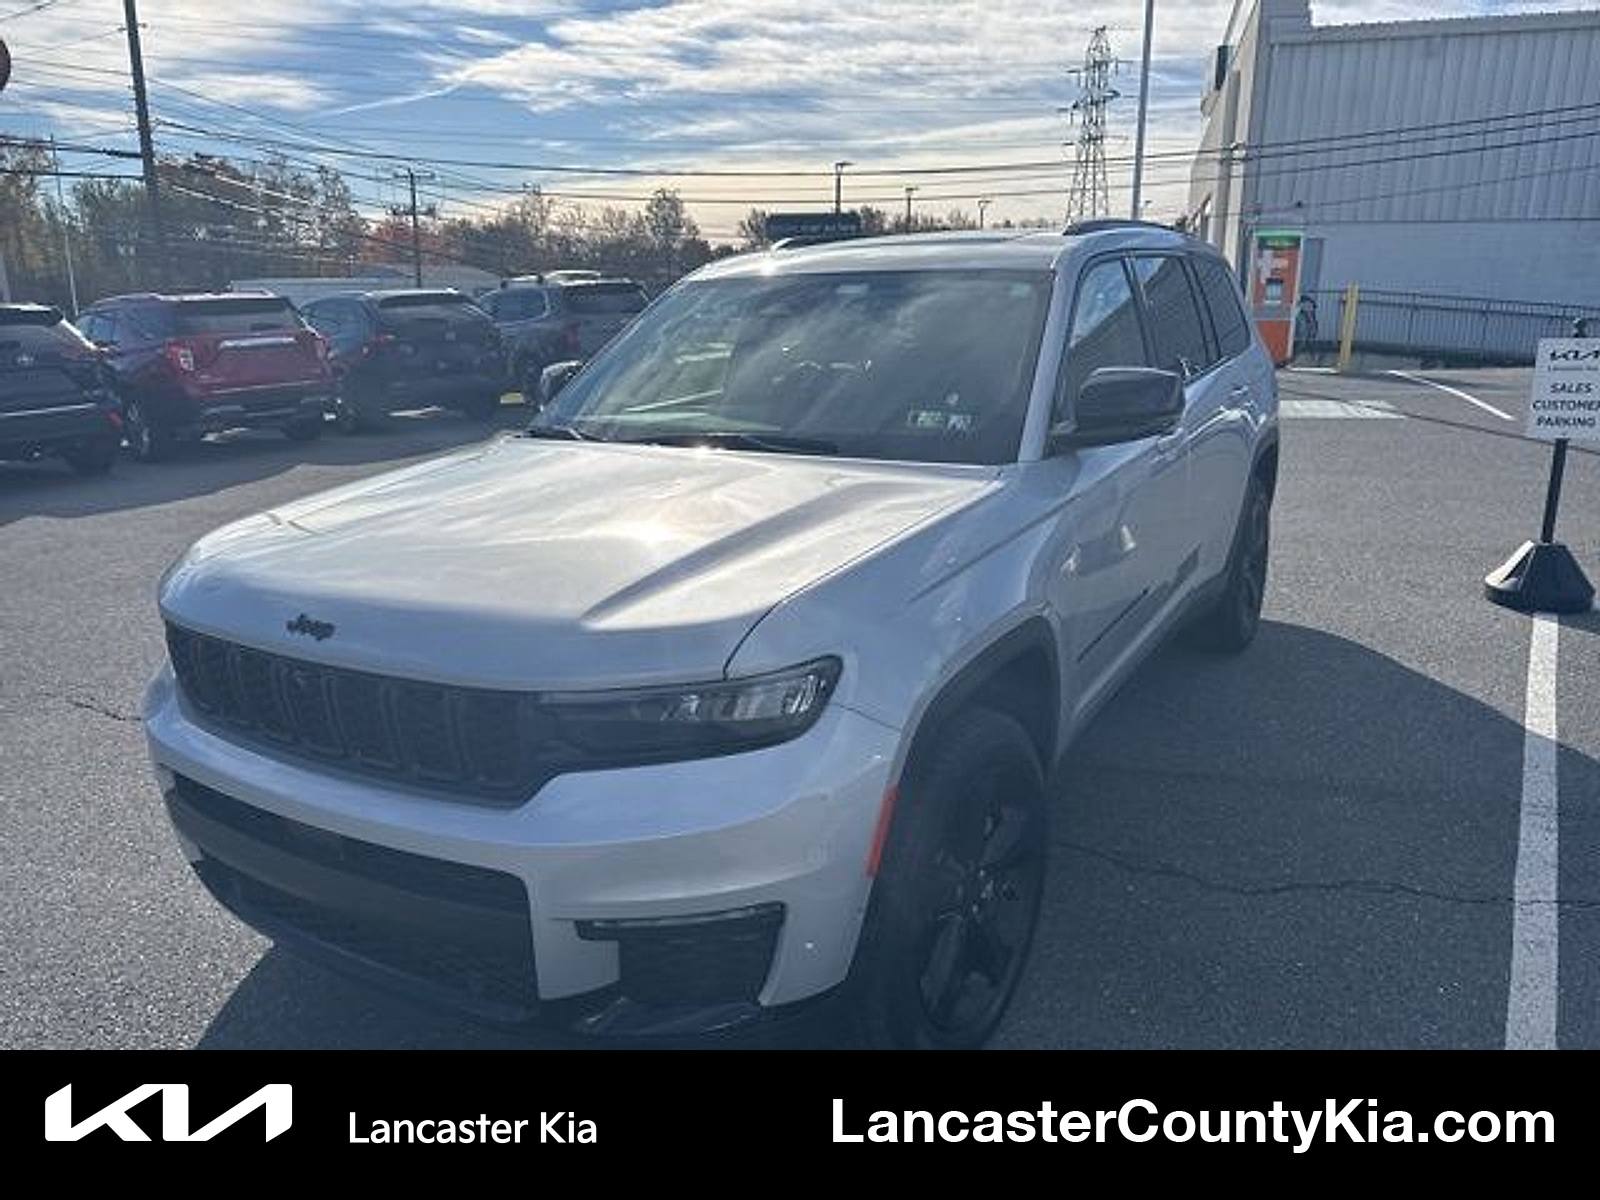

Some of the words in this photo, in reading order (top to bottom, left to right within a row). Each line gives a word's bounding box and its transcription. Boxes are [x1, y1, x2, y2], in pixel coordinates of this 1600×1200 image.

[1550, 383, 1592, 393] SALES
[1537, 417, 1596, 427] PARKING
[286, 612, 335, 641] Jeep
